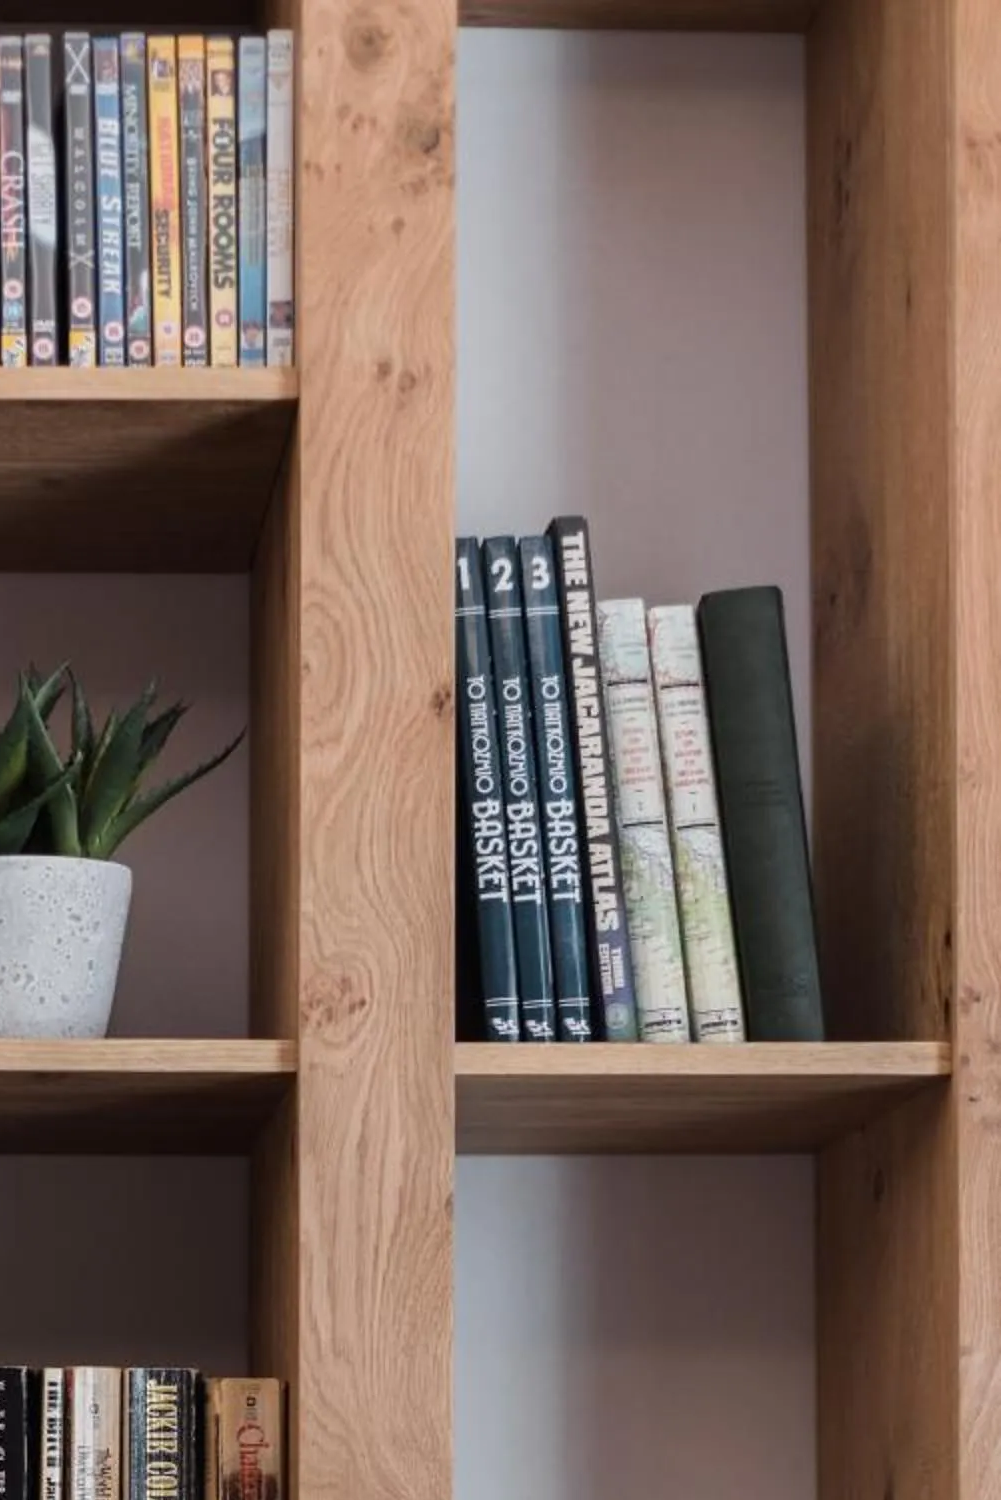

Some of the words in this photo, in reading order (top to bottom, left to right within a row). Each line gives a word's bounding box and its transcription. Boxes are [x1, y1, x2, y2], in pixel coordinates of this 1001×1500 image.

[98, 118, 121, 180] BLUE
[123, 84, 141, 178] MINORITY
[211, 117, 234, 185] FOUR
[0, 151, 24, 248] CRASH
[74, 127, 87, 246] MALCOLM
[125, 182, 141, 252] REPORT
[70, 250, 94, 269] X
[100, 195, 121, 295] STREAK
[155, 208, 172, 299] SECURITY
[212, 193, 235, 290] ROOMS
[457, 557, 470, 591] 1
[490, 557, 515, 593] 2
[531, 556, 551, 590] 3
[561, 531, 588, 587] THE
[566, 590, 596, 656] NEW
[572, 658, 607, 835] JACARANDA
[588, 842, 619, 931] ATLAS
[598, 942, 614, 996] EDITION
[610, 947, 625, 989] THIRD
[46, 1380, 62, 1412] THE
[145, 1380, 178, 1453] JACKIE
[46, 1415, 62, 1468] BITCH
